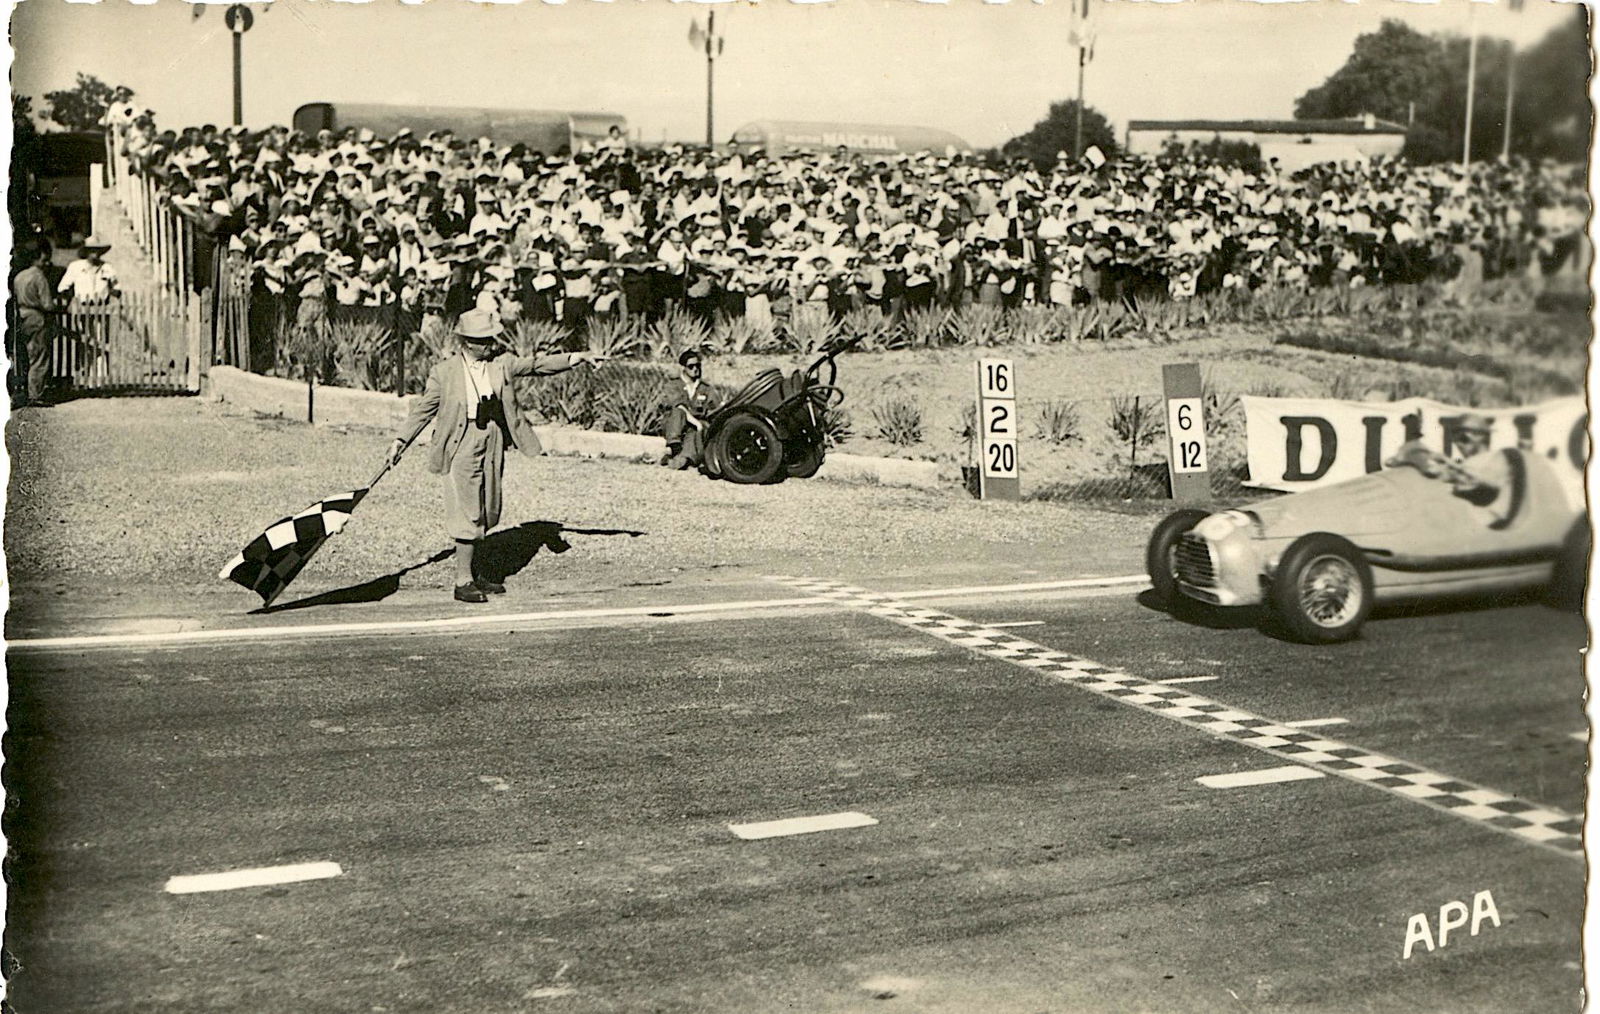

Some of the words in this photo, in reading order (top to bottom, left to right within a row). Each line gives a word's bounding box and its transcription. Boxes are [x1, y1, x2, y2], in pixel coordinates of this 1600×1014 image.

[987, 364, 1008, 392] 16
[990, 405, 1008, 433] 2
[1178, 404, 1192, 430] 6
[988, 443, 1014, 472] 20
[1180, 441, 1202, 469] 12
[1280, 412, 1588, 481] DUN
